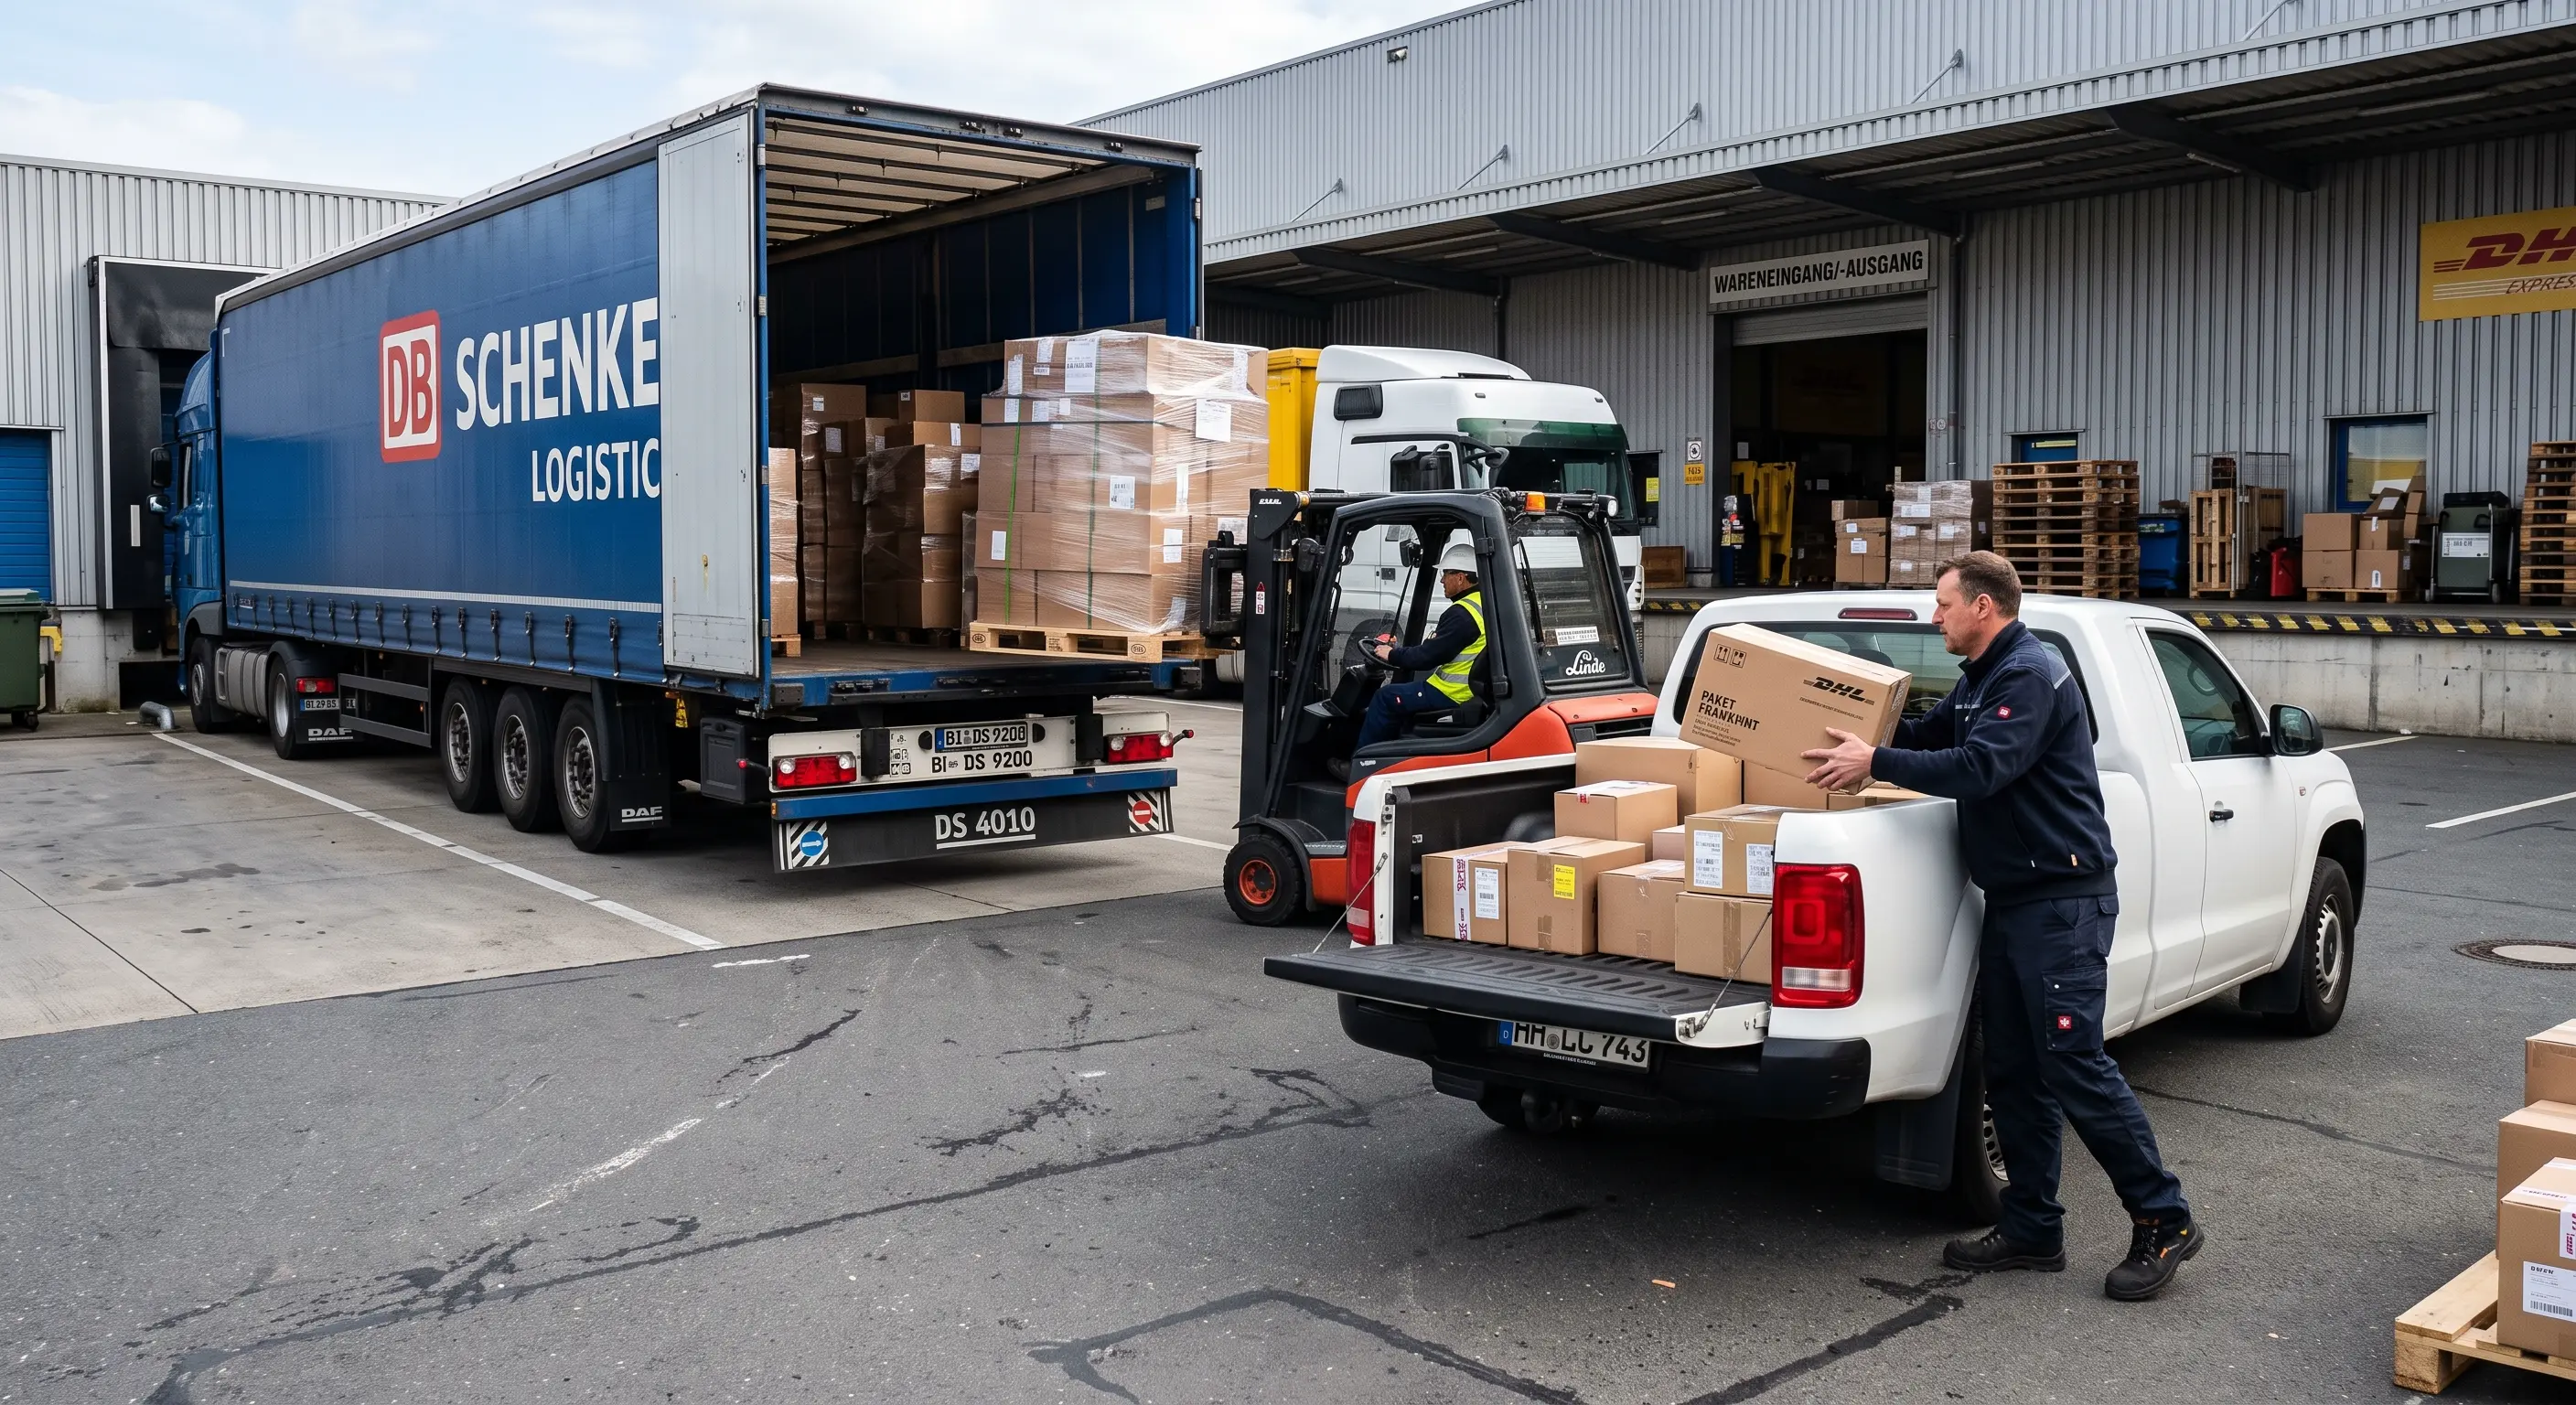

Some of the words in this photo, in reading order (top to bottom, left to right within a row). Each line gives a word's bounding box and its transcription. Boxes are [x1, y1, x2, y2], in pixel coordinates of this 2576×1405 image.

[1714, 250, 1923, 294] WARENEINGANG/-AUSGANG
[2506, 274, 2576, 295] EXPRES
[387, 338, 433, 438] DB
[456, 297, 660, 431] SCHENKE
[531, 437, 660, 503] LOGISTIC
[1565, 649, 1606, 676] Linde
[1701, 690, 1736, 710] PAKET
[1812, 676, 1866, 702] DHL
[308, 727, 353, 736] DAF
[946, 730, 962, 746] BI
[972, 727, 990, 744] DS
[931, 756, 947, 773] BI
[963, 753, 985, 771] DS
[993, 750, 1033, 768] 9200
[621, 806, 662, 818] DAF
[934, 812, 968, 841] DS
[975, 806, 1036, 835] 4010
[1514, 1022, 1546, 1047] HH
[1602, 1035, 1647, 1063] 743
